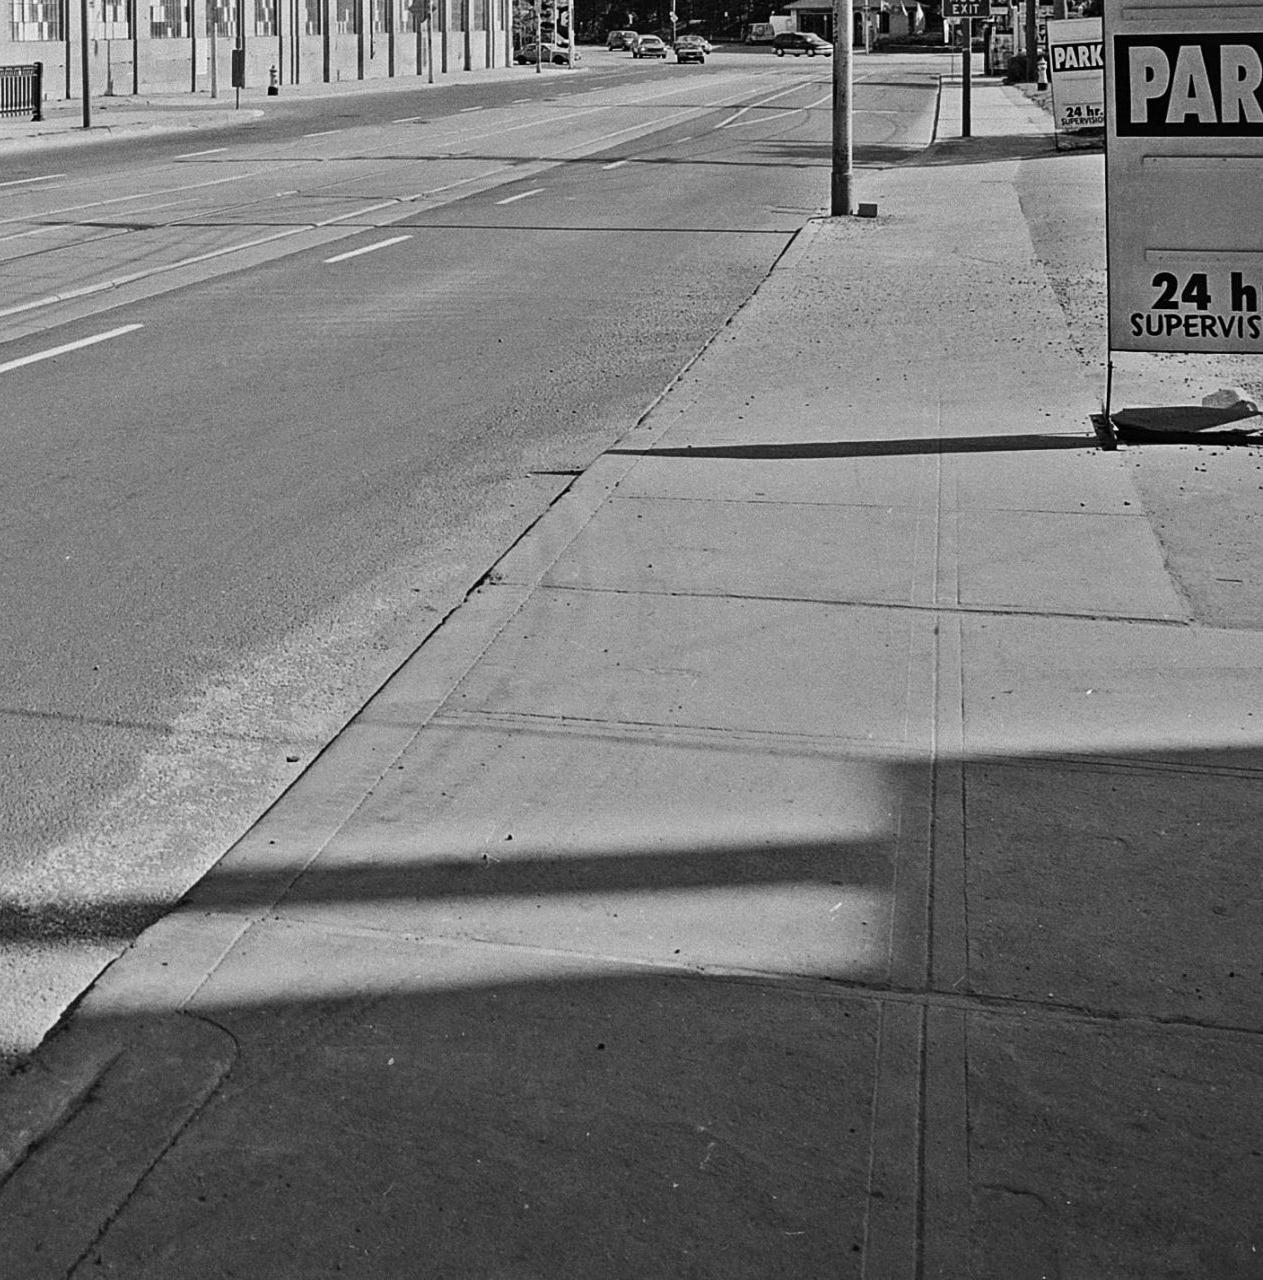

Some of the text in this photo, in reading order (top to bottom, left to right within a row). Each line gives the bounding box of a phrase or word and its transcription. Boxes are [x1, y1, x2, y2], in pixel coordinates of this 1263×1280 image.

[952, 3, 980, 15] EXIT
[1054, 44, 1104, 69] PARK
[1128, 44, 1263, 123] PAR
[1065, 104, 1104, 118] 24 hr.
[1150, 271, 1263, 312] 24 h
[1130, 312, 1262, 339] SUPERVIS
